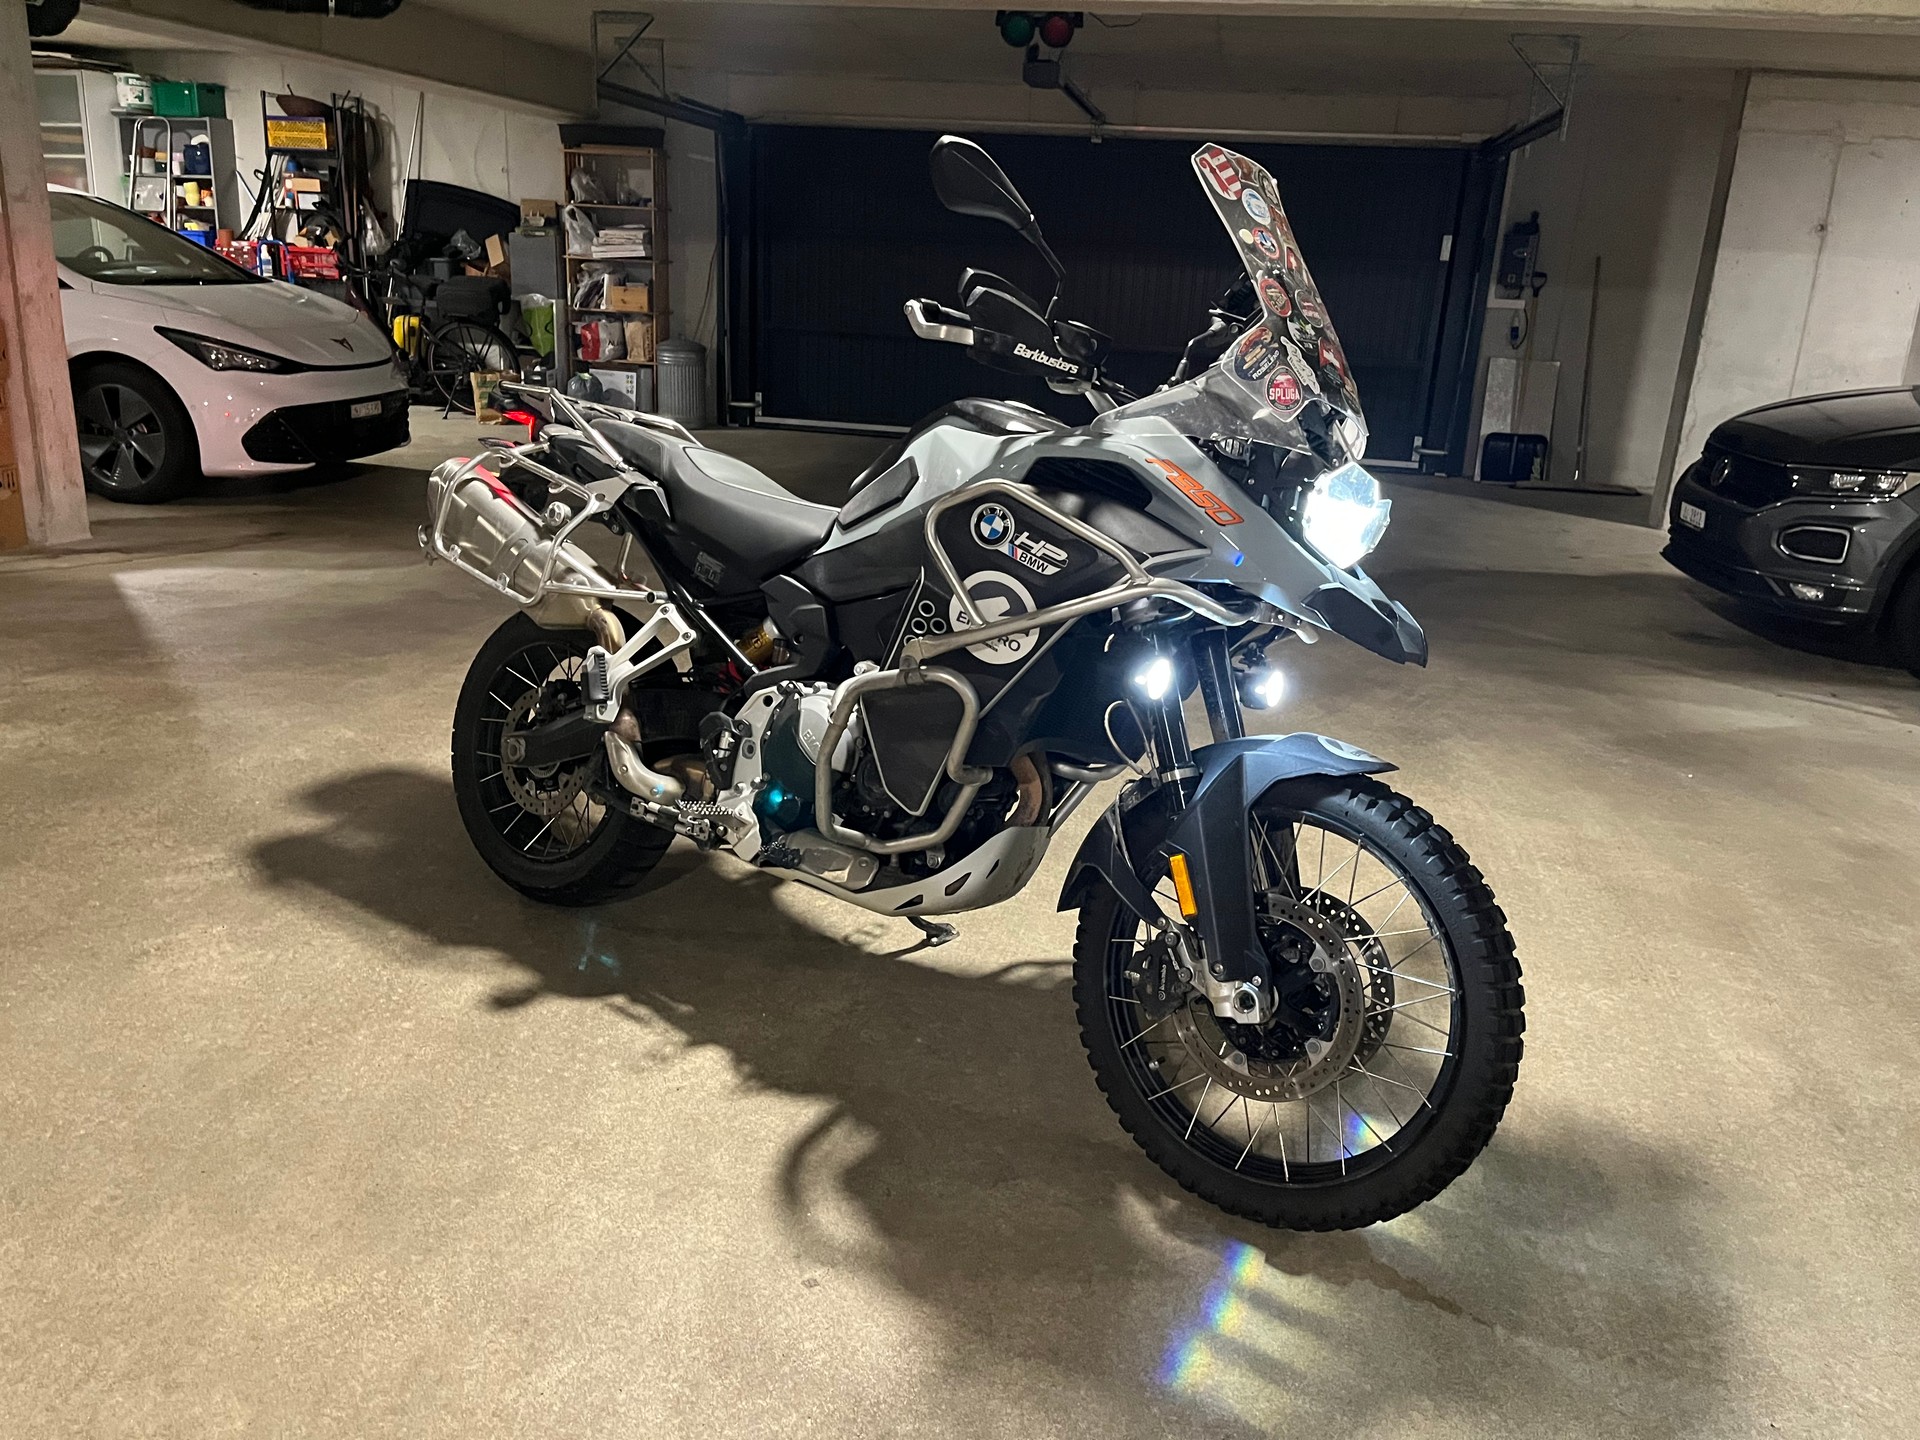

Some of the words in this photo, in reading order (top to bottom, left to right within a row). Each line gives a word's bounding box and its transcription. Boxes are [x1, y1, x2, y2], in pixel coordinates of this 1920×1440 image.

[1013, 342, 1079, 374] Barkbusters
[1269, 387, 1300, 400] SPLUGA
[1013, 531, 1069, 562] HP
[1019, 552, 1049, 573] BMW
